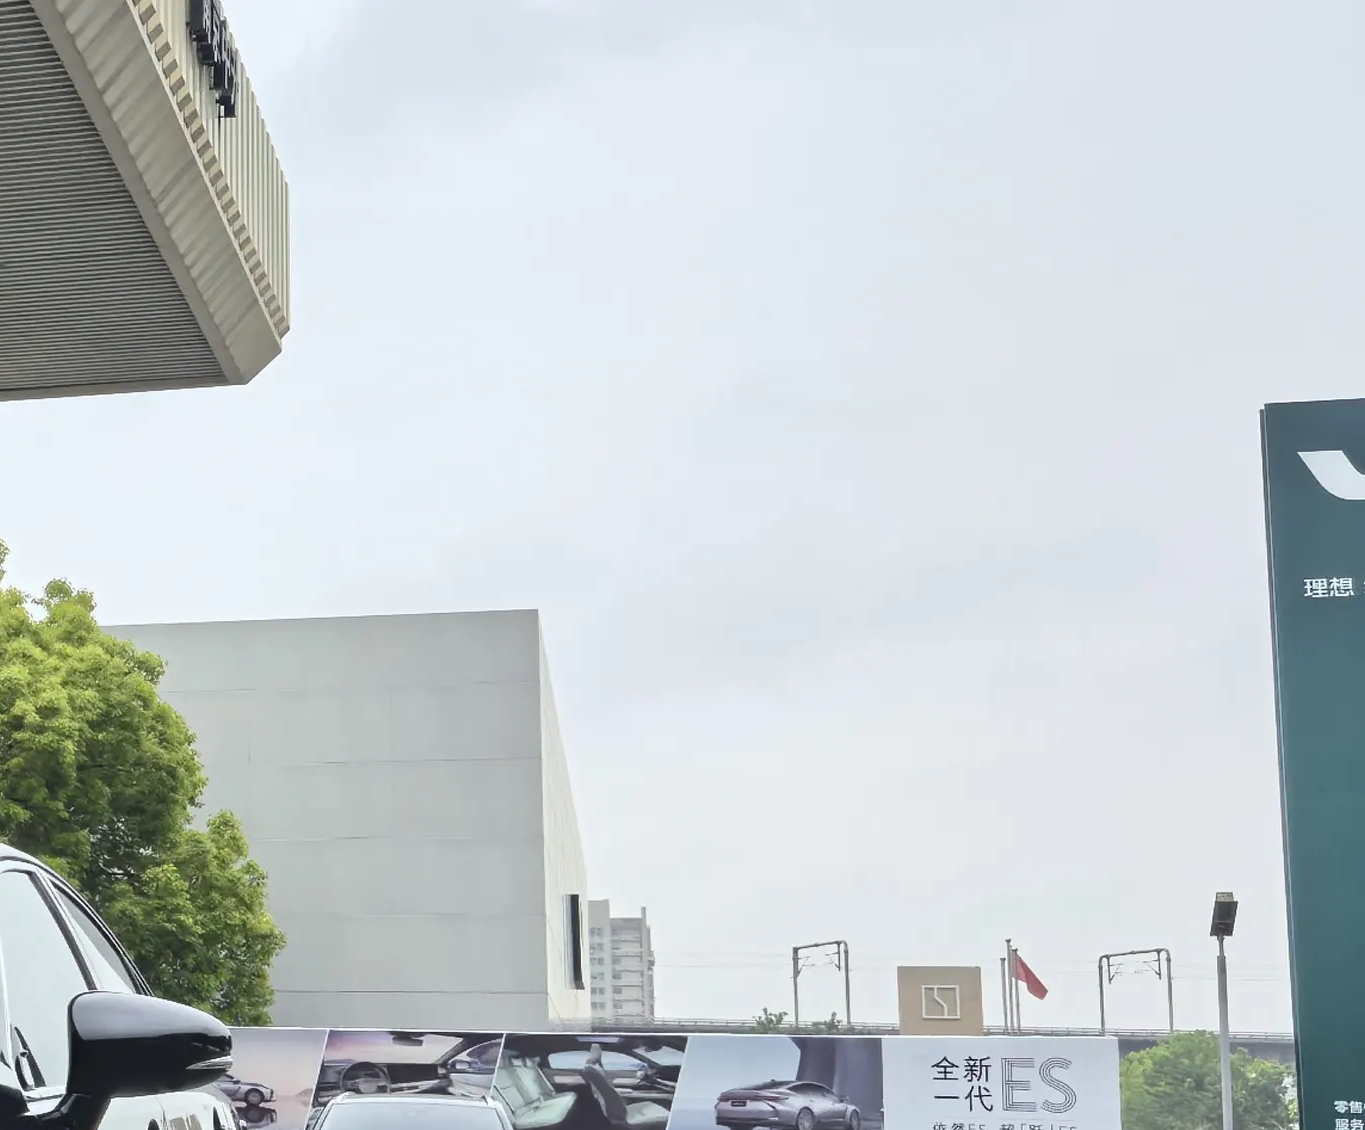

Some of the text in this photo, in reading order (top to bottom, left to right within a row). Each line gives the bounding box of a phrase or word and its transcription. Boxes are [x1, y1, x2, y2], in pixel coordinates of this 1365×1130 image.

[1303, 576, 1356, 598] 理想
[931, 1056, 992, 1083] 全新
[934, 1085, 994, 1112] 一代
[1001, 1057, 1077, 1114] ES
[1334, 1100, 1365, 1114] 零售
